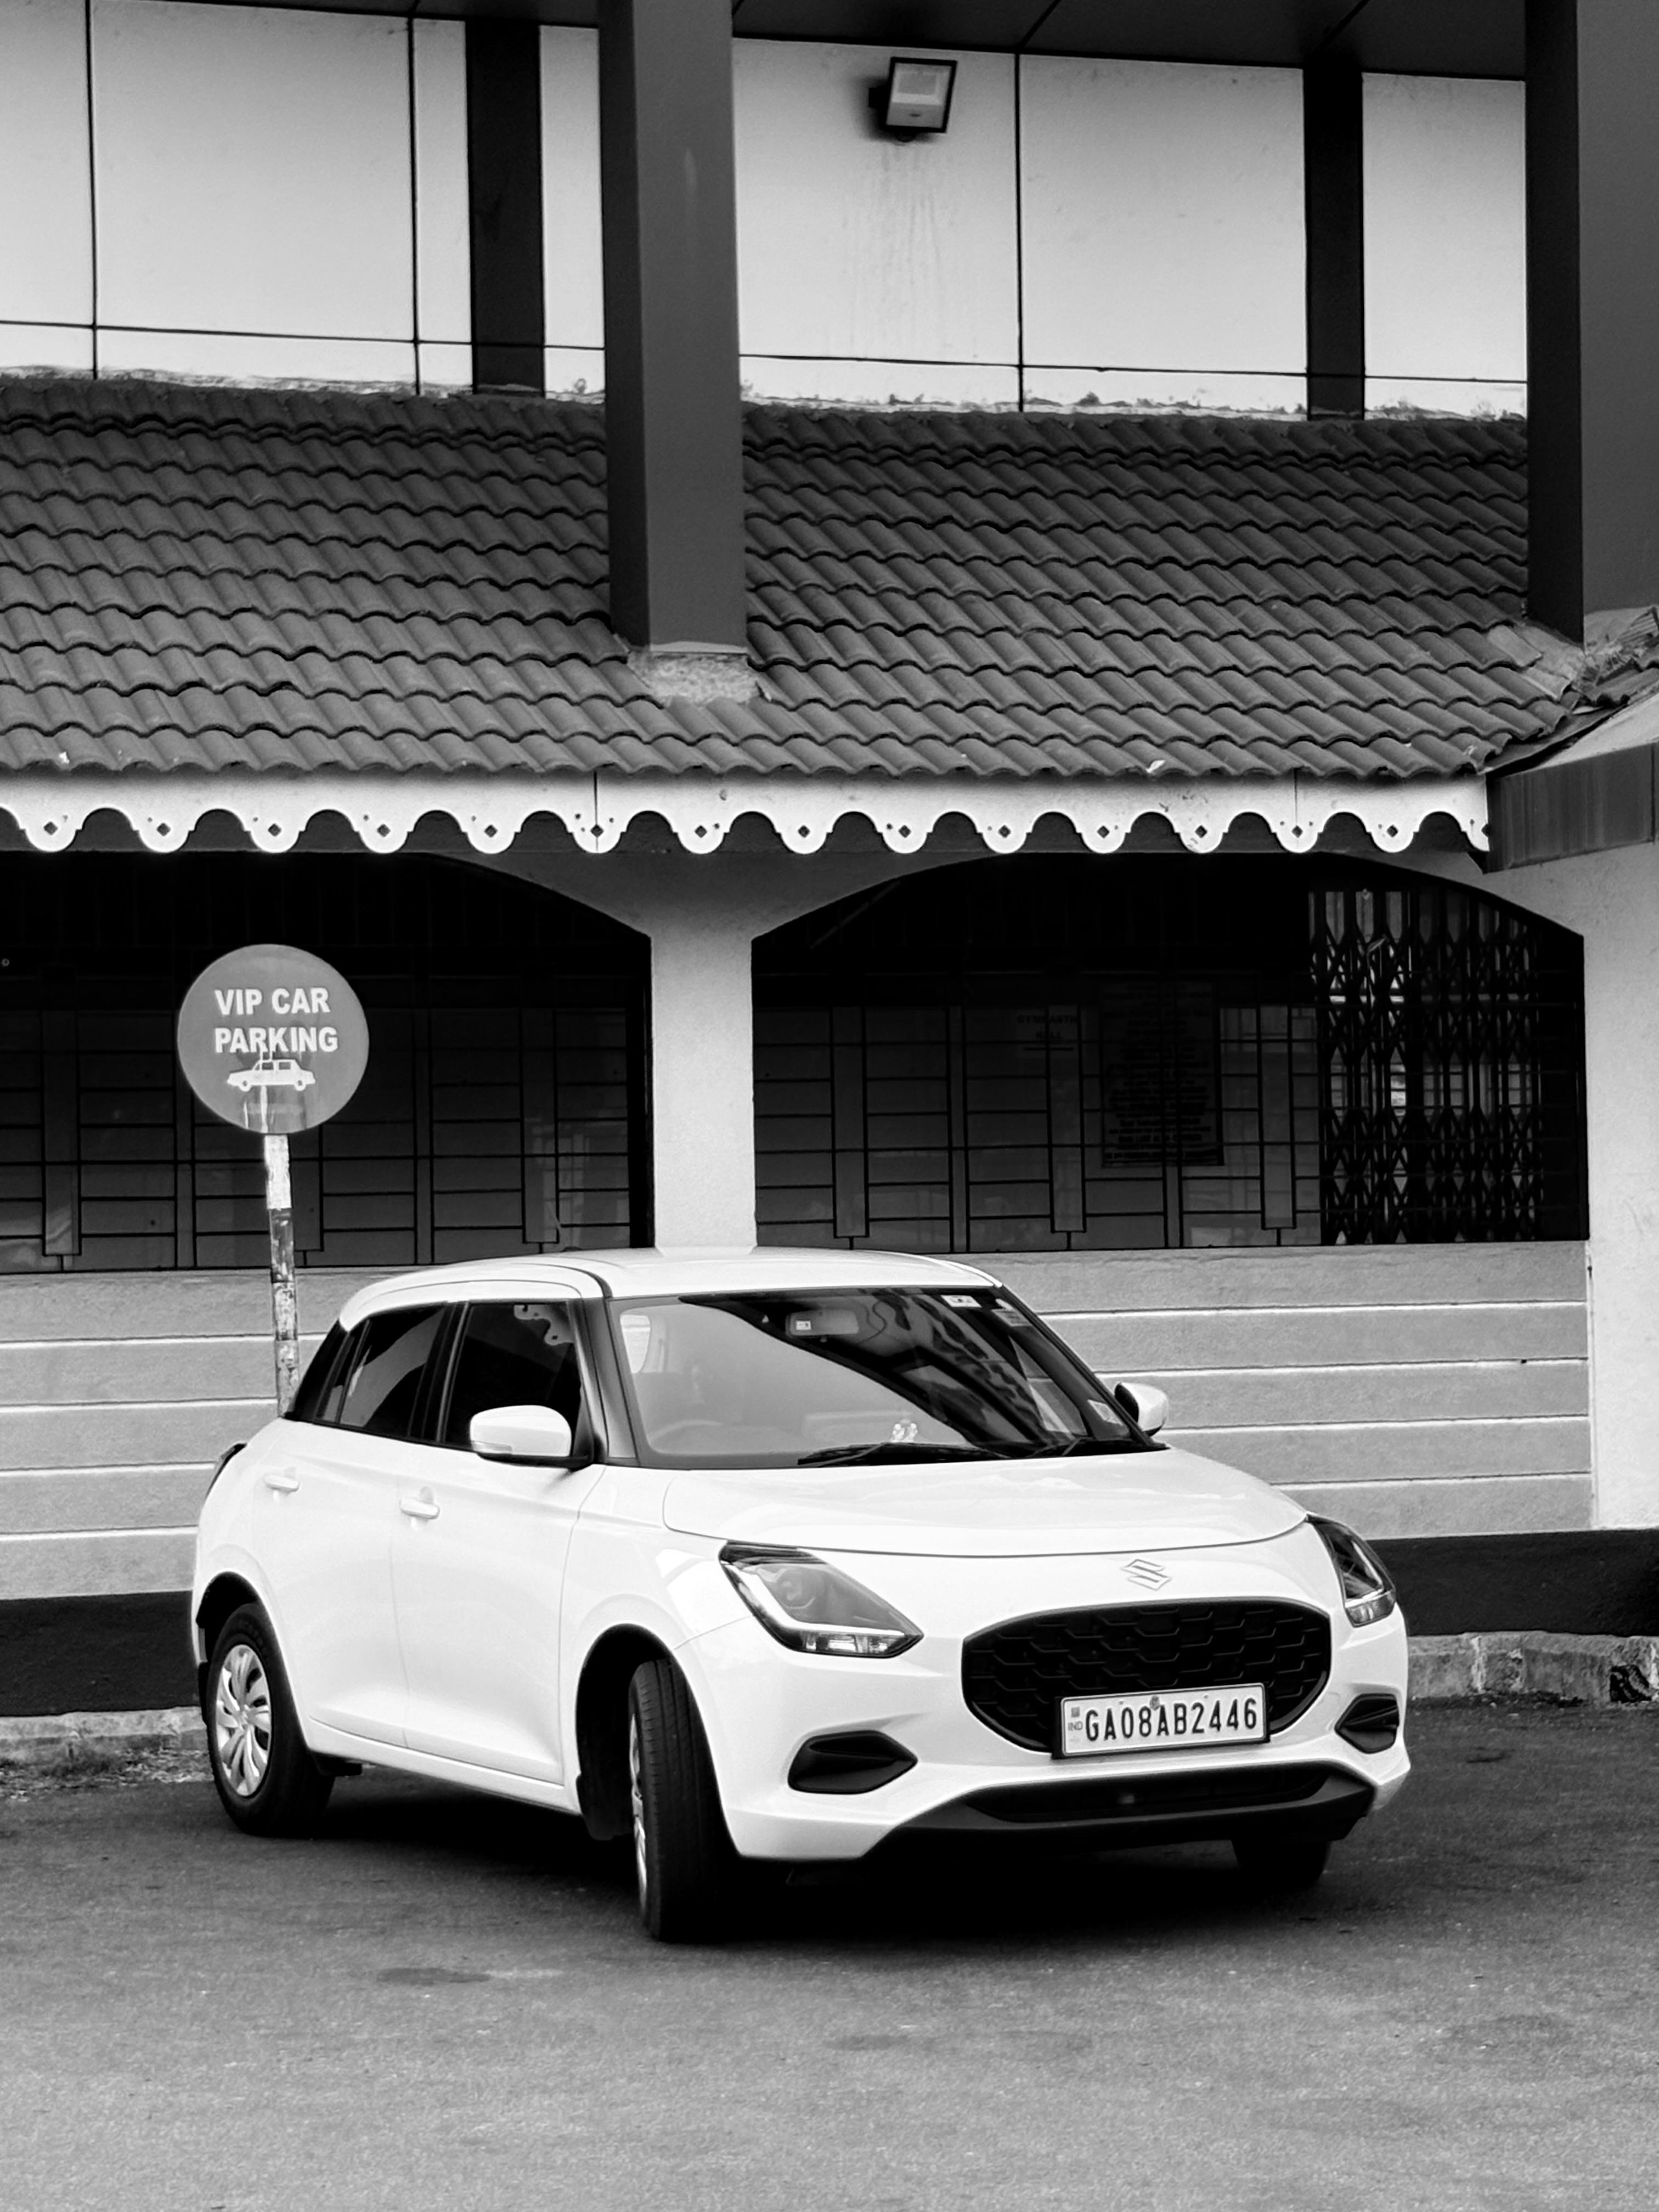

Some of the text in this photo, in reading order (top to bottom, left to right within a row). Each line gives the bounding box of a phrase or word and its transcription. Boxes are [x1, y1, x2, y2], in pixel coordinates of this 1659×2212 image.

[214, 987, 331, 1015] VIP CAR
[215, 1026, 338, 1053] PARKING
[1085, 1697, 1257, 1741] GA08AB2446
